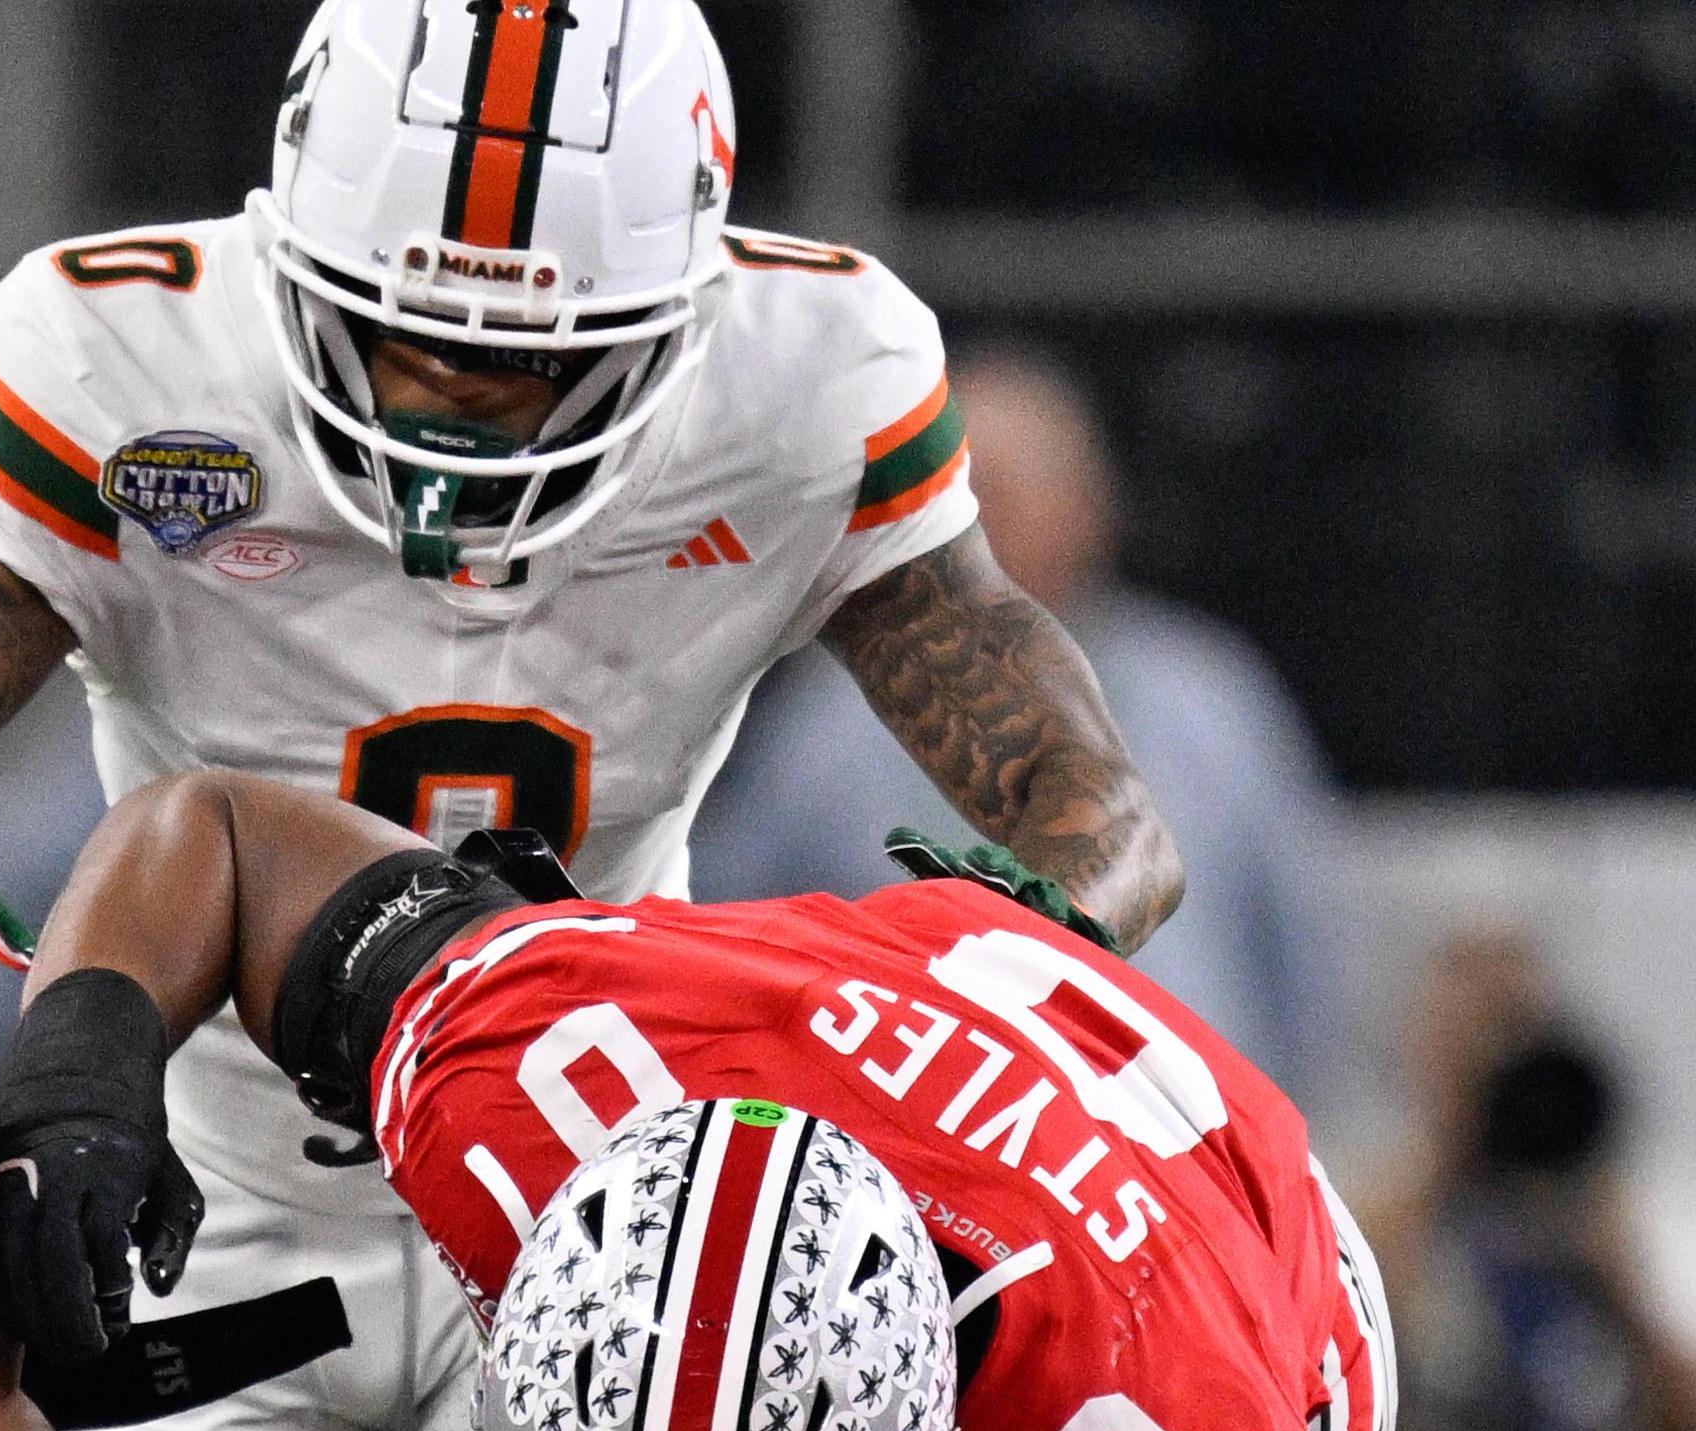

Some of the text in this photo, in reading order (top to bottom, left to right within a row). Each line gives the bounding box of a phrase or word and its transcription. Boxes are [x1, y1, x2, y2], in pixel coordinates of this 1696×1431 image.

[51, 239, 204, 292] 0
[438, 250, 525, 281] MIAMI
[113, 465, 251, 511] COTTON
[926, 929, 1229, 1160] 0
[516, 1002, 686, 1162] 0
[735, 1104, 785, 1122] C2P
[809, 980, 1168, 1263] STYLES
